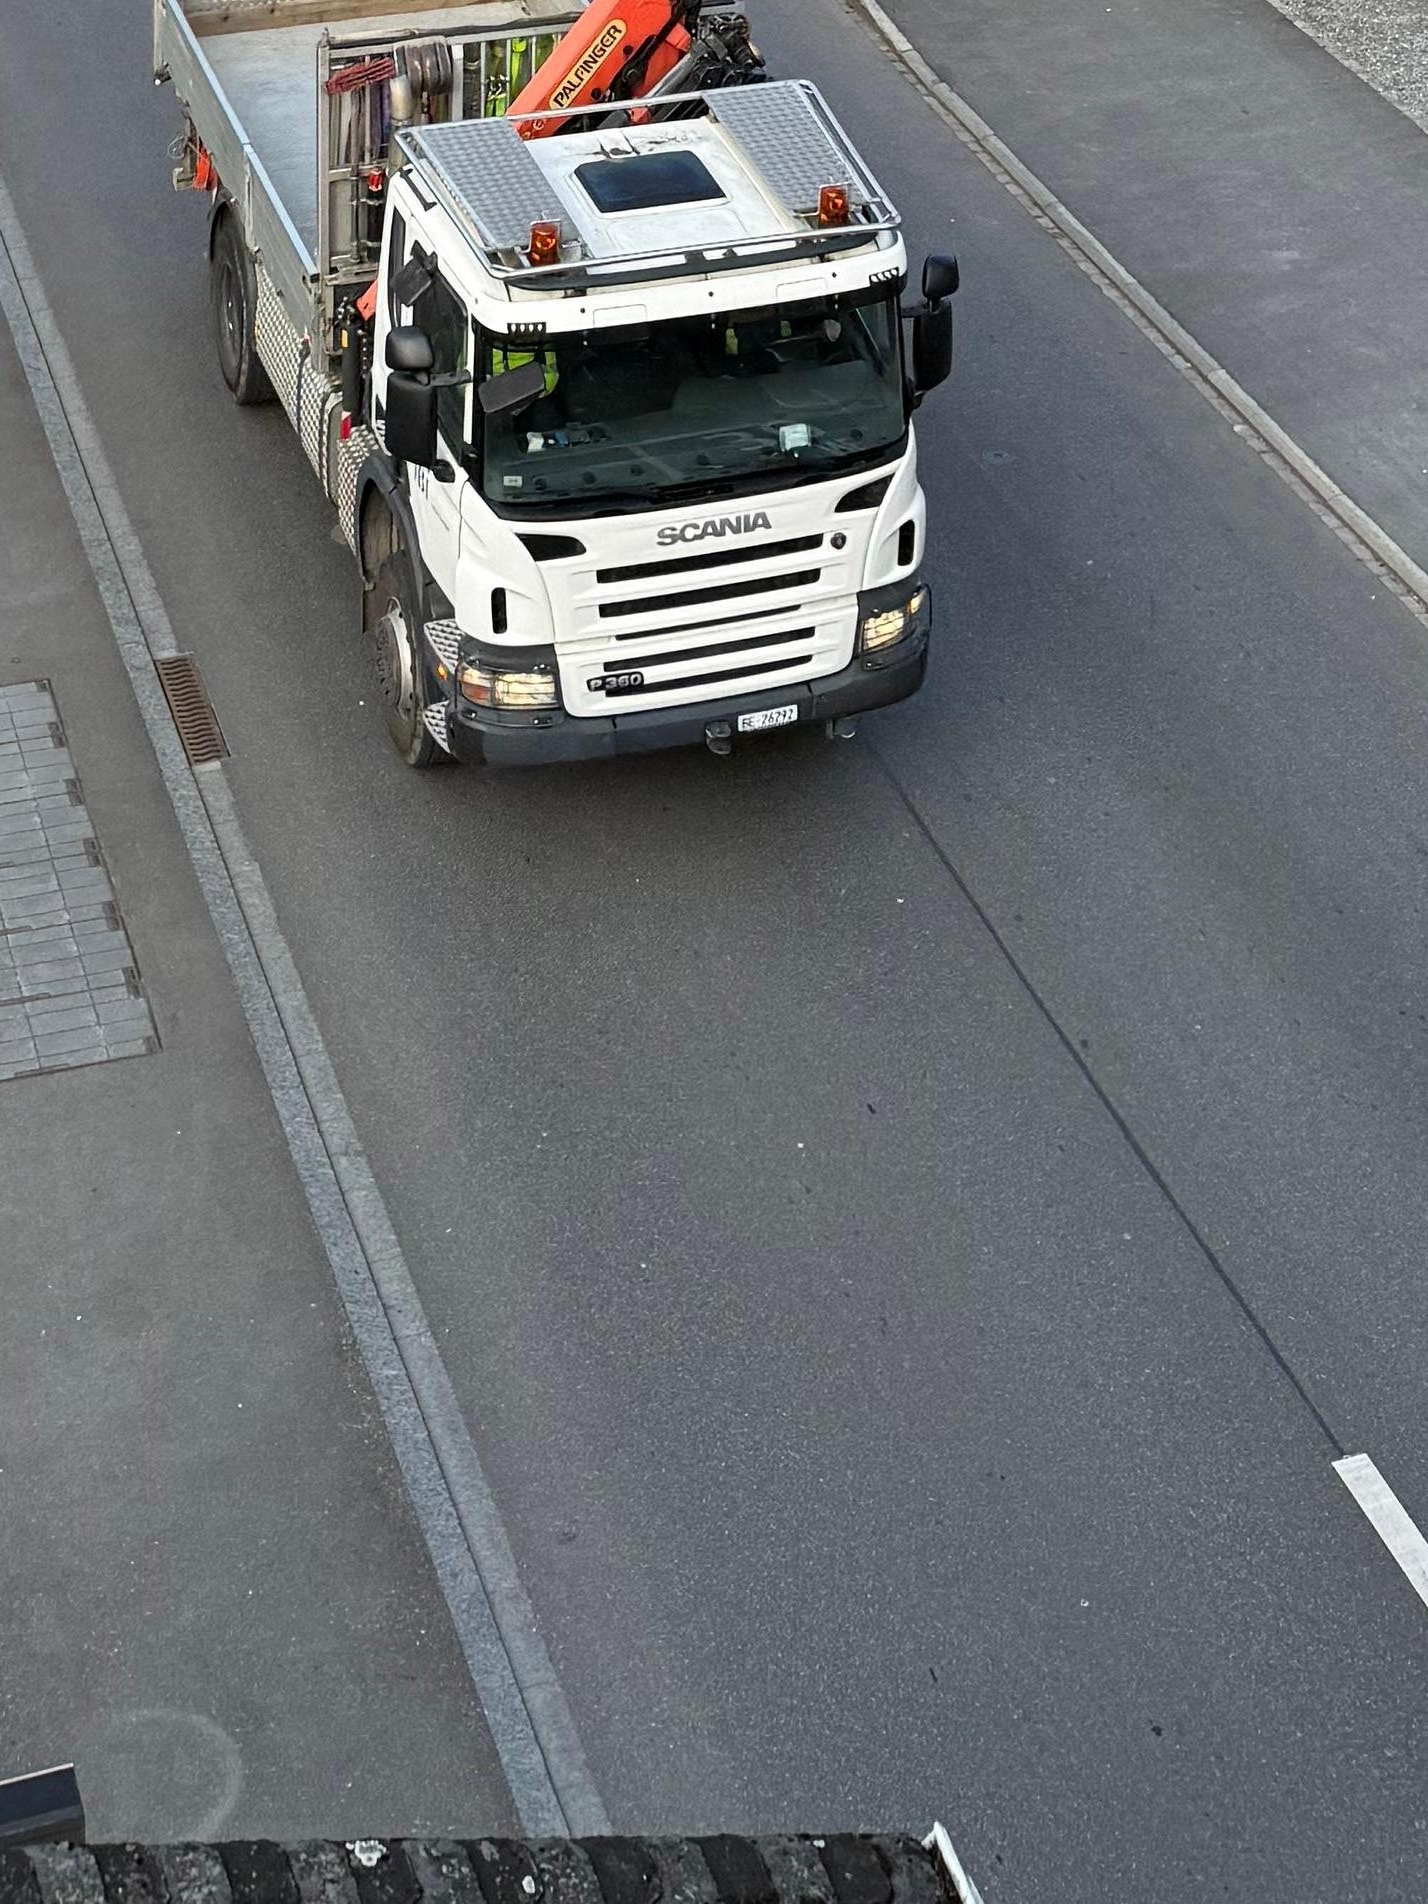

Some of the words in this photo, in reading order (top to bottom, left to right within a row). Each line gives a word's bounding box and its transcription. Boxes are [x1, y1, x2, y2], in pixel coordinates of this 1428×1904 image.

[552, 24, 623, 108] PALFINGER
[656, 511, 772, 546] SCANIA
[589, 679, 602, 691] P
[605, 672, 643, 690] 360
